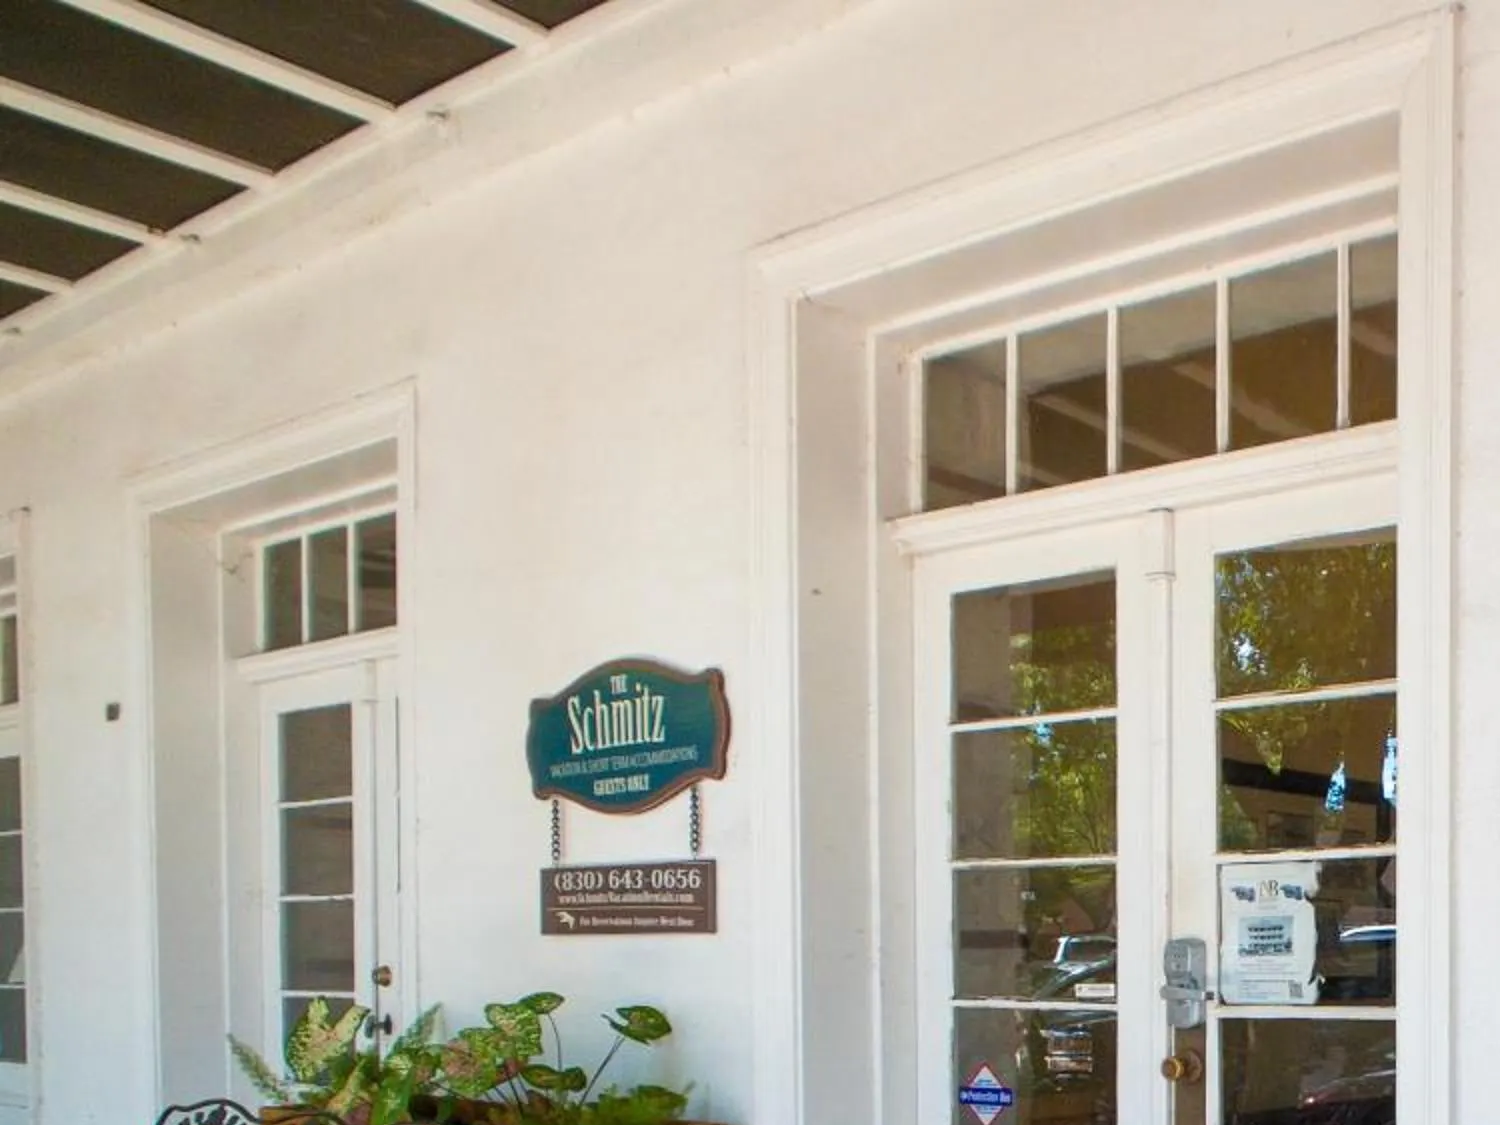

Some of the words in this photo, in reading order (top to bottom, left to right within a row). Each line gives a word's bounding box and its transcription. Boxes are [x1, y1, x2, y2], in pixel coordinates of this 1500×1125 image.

[610, 674, 628, 695] THE
[568, 681, 665, 755] Schmitz
[554, 871, 604, 892] (830)
[608, 868, 701, 889] 643-0656
